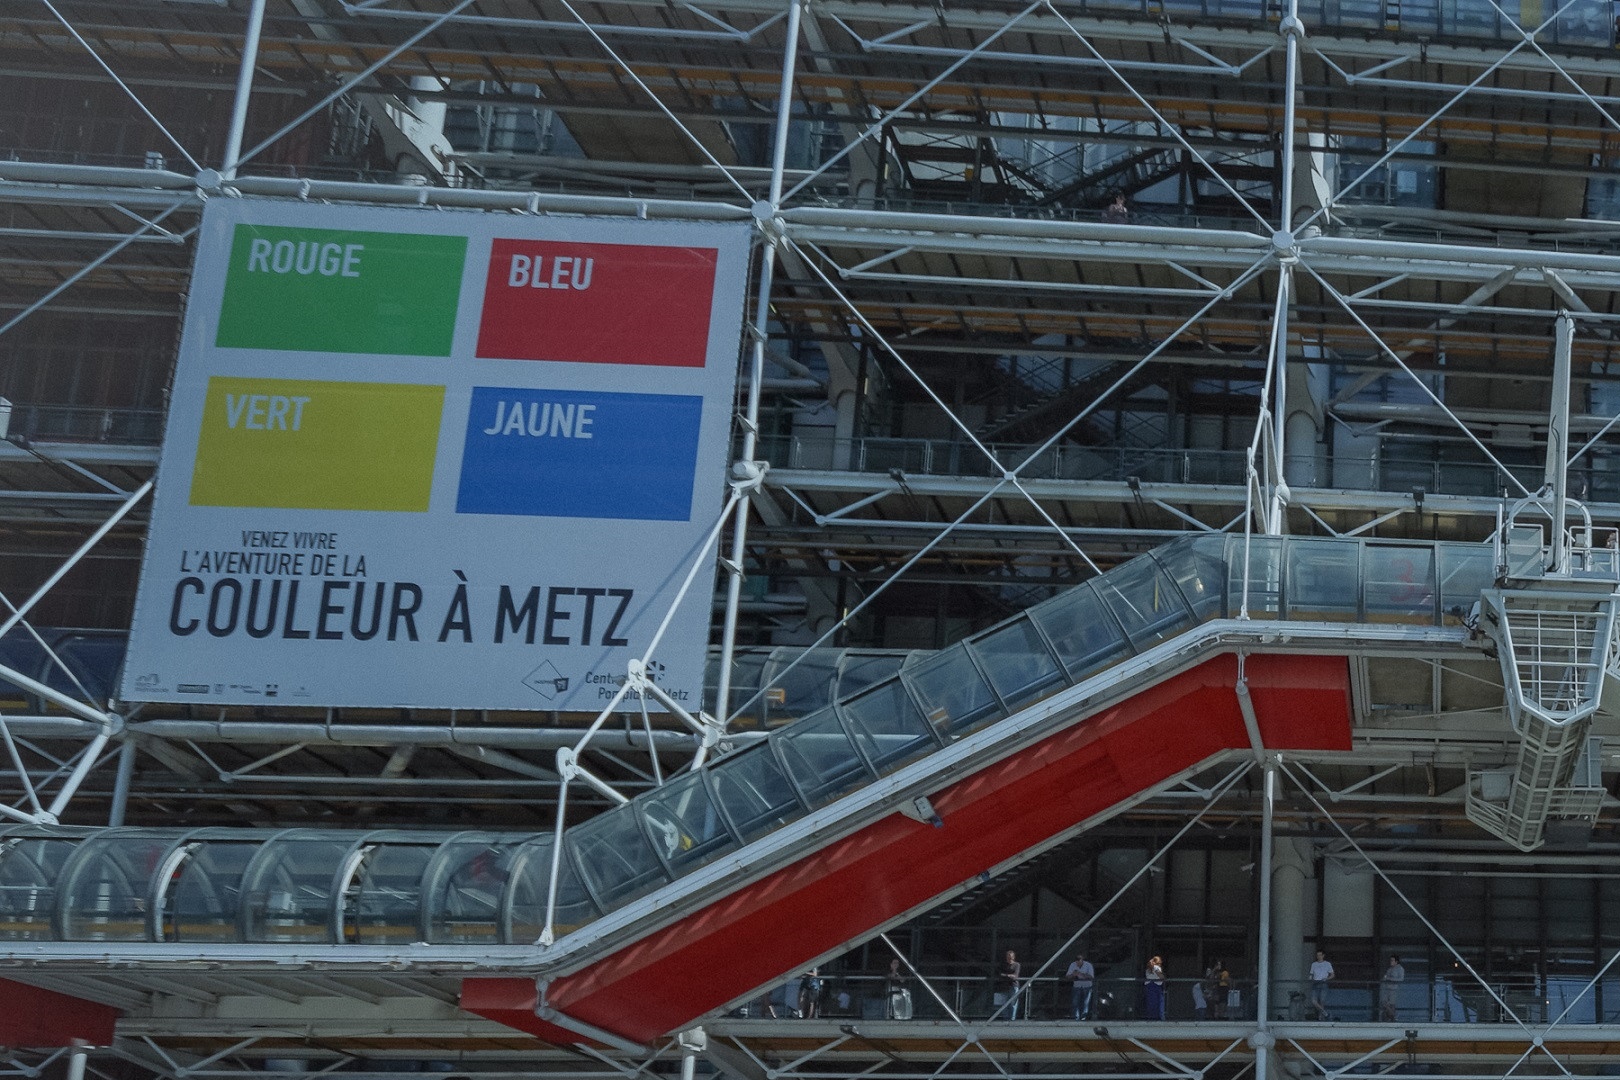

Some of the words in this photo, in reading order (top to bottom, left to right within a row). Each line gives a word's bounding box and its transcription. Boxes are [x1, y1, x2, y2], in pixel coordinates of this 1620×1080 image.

[247, 238, 365, 278] ROUGE
[508, 253, 595, 291] BLEU
[225, 393, 311, 432] VERT
[484, 401, 597, 439] JAUNE
[241, 530, 288, 548] VENEZ
[293, 531, 338, 550] VIVRE
[180, 550, 304, 576] L'AVENTURE
[309, 553, 337, 577] DE
[342, 554, 367, 578] LA
[169, 575, 423, 642] COULEUR
[436, 568, 473, 643] À
[493, 583, 634, 647] METZ
